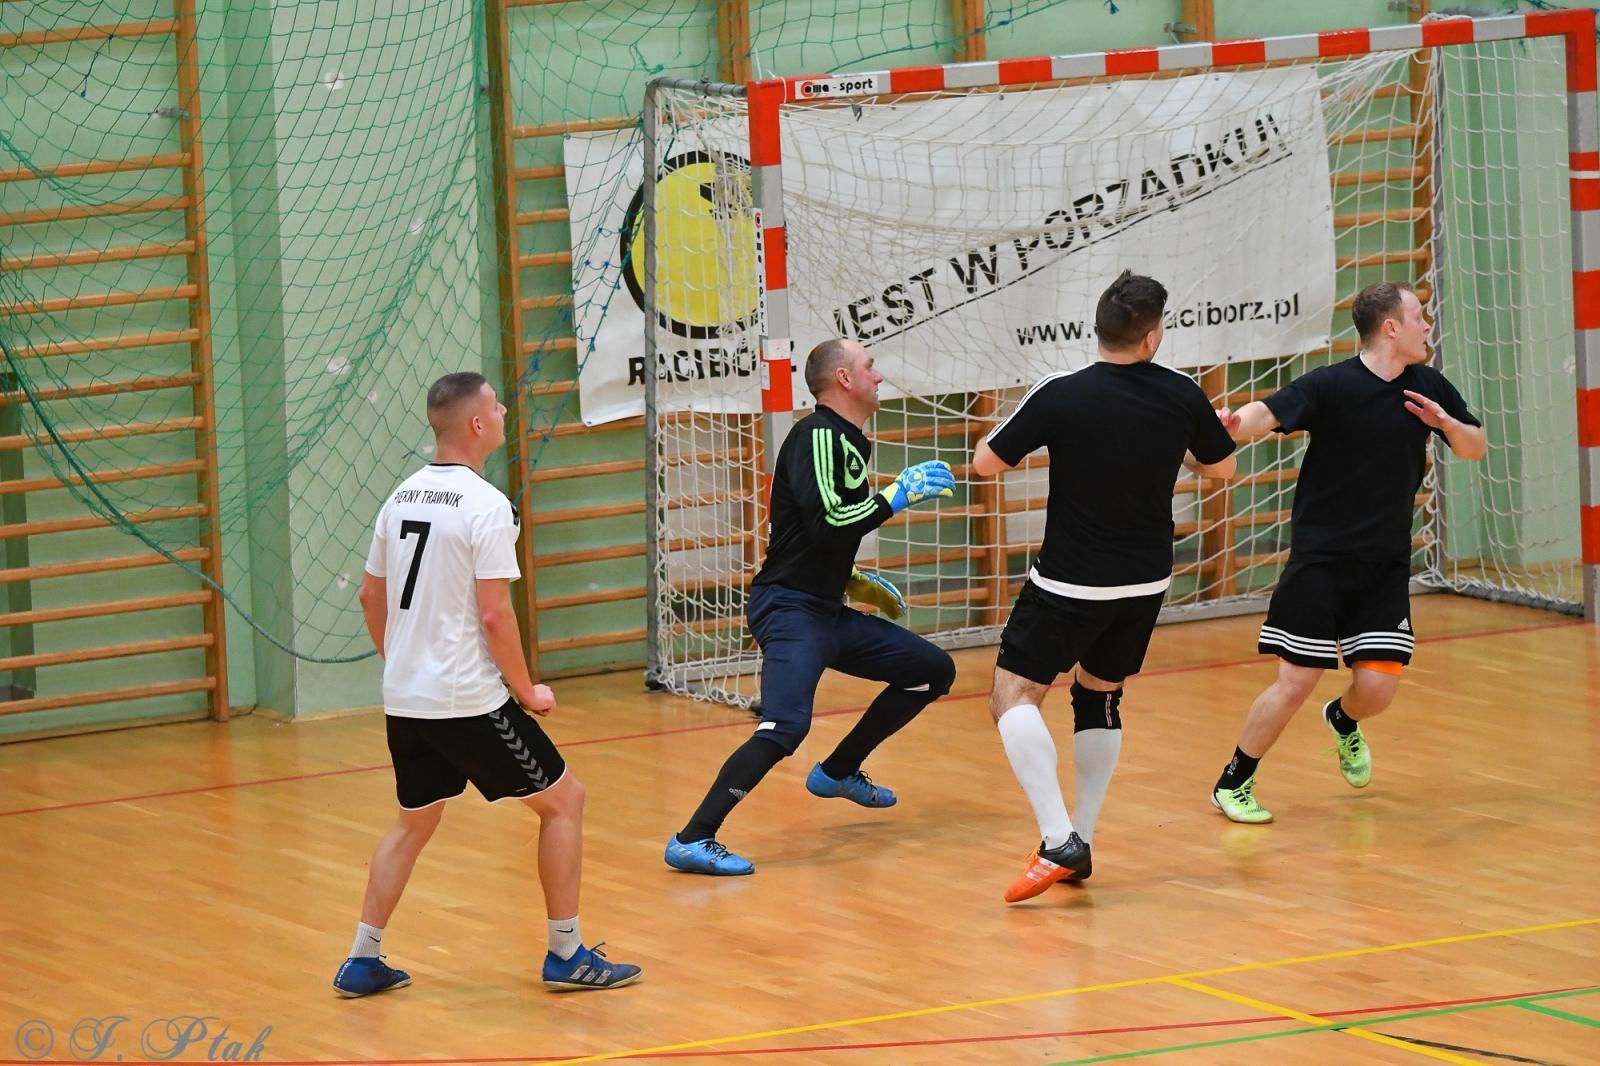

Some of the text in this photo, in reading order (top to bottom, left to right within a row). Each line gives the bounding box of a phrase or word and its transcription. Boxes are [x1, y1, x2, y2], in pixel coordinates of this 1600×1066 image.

[839, 78, 873, 93] sport
[950, 244, 1000, 294] W
[421, 490, 464, 508] TRAWNIK
[400, 520, 432, 611] 7
